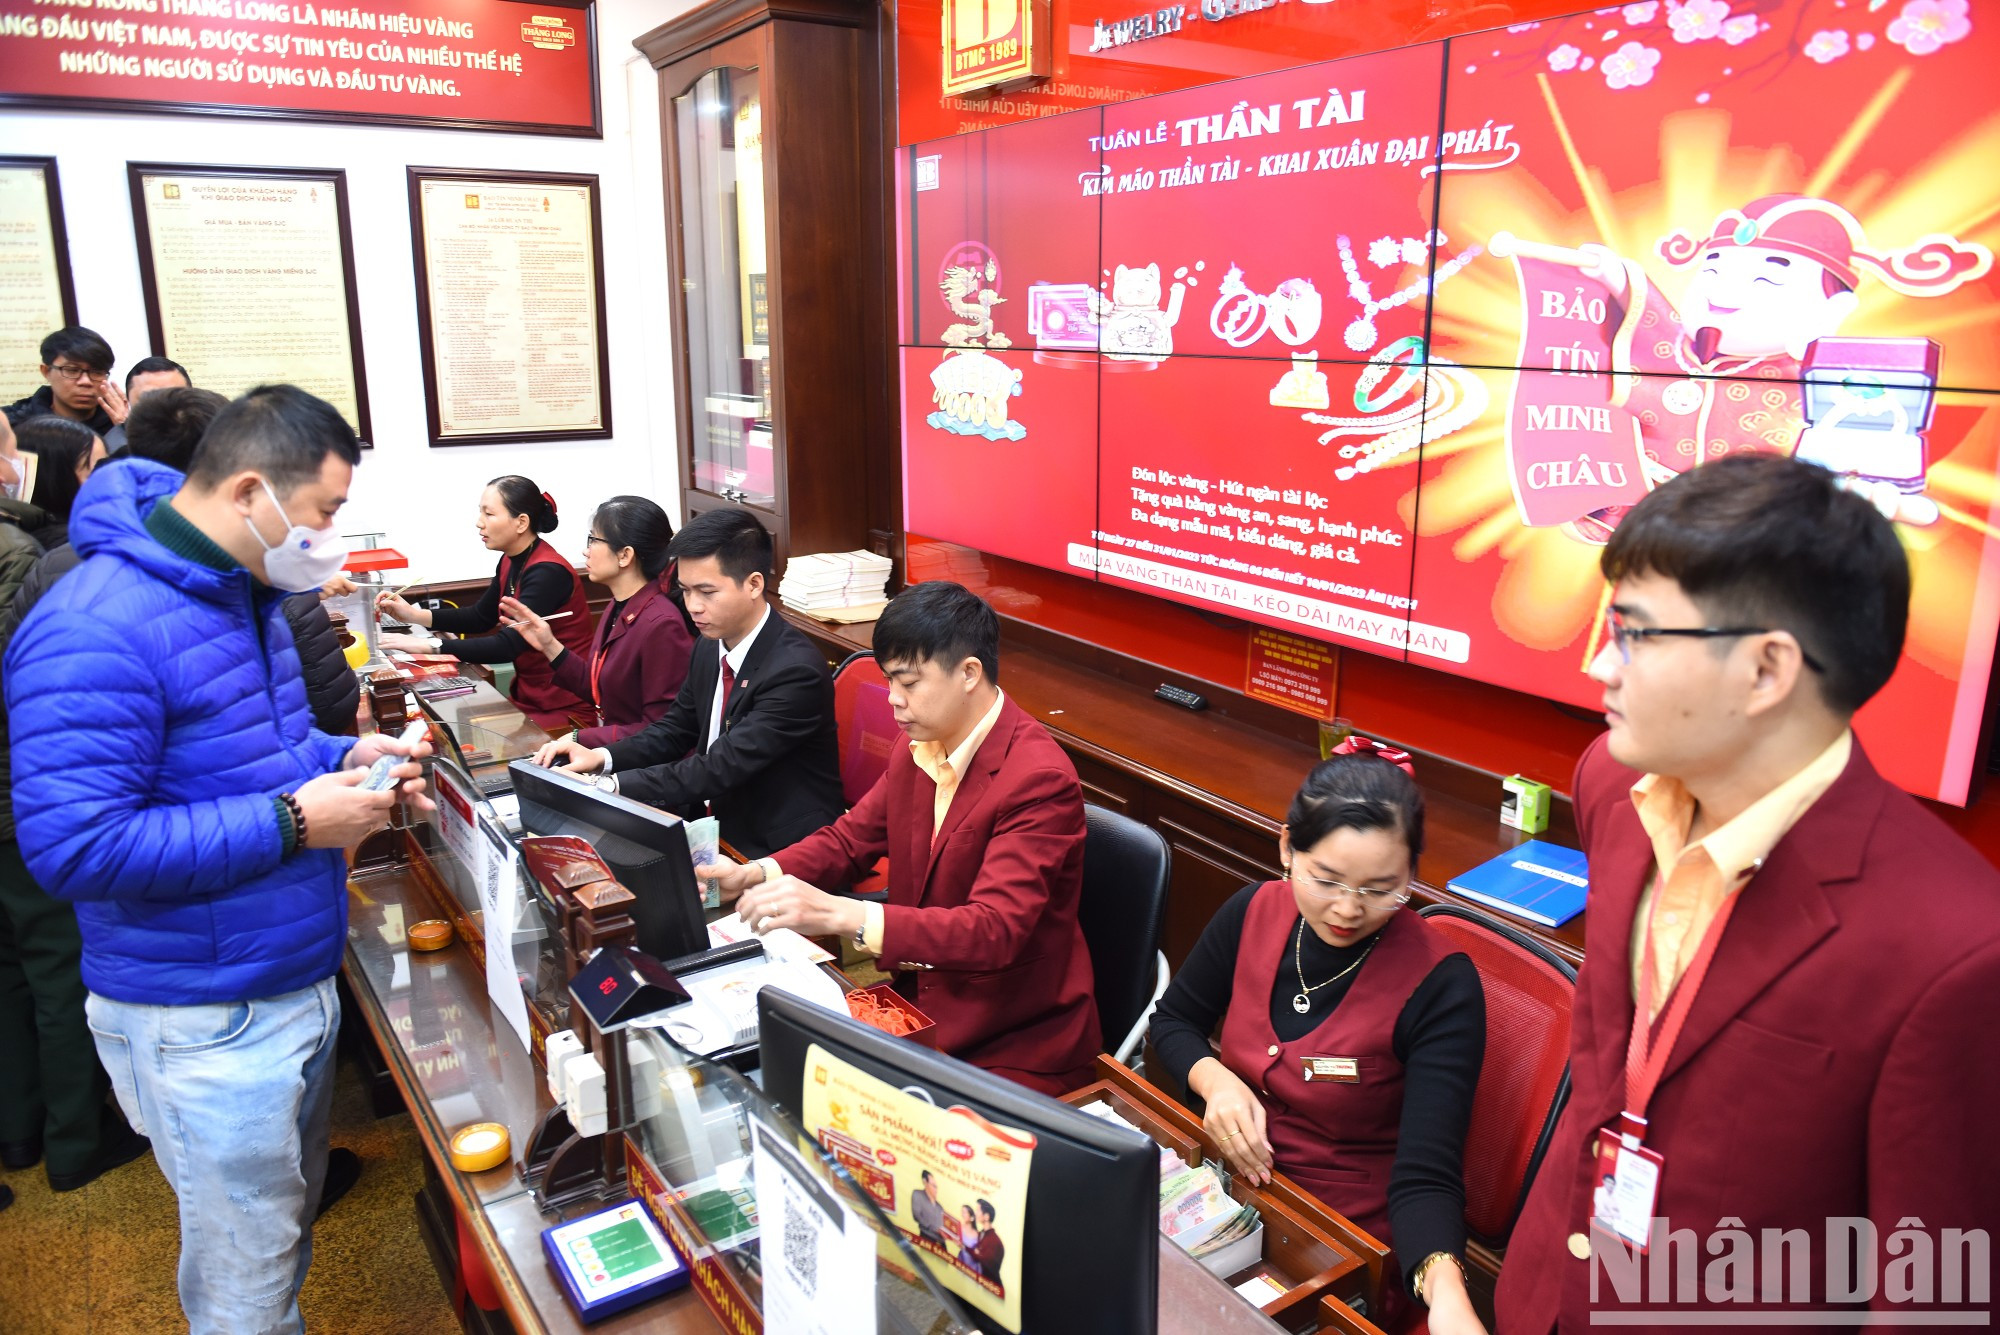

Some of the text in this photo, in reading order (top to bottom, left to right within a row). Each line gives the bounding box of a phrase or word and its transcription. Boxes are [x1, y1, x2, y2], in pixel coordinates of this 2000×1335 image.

[236, 0, 291, 23] LONG
[293, 4, 318, 26] LÀ
[321, 8, 377, 31] NHÃN
[380, 12, 422, 38] HIỆU
[424, 16, 474, 39] VÀNG
[551, 30, 573, 39] LONG
[1088, 4, 1186, 53] JEWELRY
[41, 13, 523, 77] ĐẦU VIỆT NAM, ĐƯỢC SỰ TIN YÊU CỦA NHIỀU THẾ HỆ
[956, 38, 1017, 71] BTMC 1989
[59, 49, 461, 97] NHỮNG NGƯỜI SỬ DỤNG VÀ ĐẦU TƯ VÀNG.
[1088, 87, 1365, 152] TUẦN LỄ THẦN TÀI
[1079, 168, 1114, 196] KIM
[1117, 167, 1155, 193] MÃO
[1158, 155, 1206, 188] THẦN
[1210, 155, 1241, 182] TÀI
[1257, 151, 1311, 177] KHAI
[1312, 138, 1380, 171] XUÂN
[1384, 135, 1430, 167] ĐẠI
[1432, 119, 1518, 165] PHÁT
[1540, 287, 1607, 324] BẢO
[1545, 341, 1600, 379] TÍN
[1525, 404, 1613, 433] MINH
[1132, 466, 1328, 510] Đón lộc vàng Hút ngàn tài lộc
[1526, 453, 1628, 490] CHÂU
[1130, 487, 1403, 547] Tặng quà bằng vàng an, sang, hạnh phúc
[1131, 507, 1360, 564] Đa dạng mẫu mã, kiểu dáng, giá cả.
[1078, 551, 1113, 571] MUA
[1116, 560, 1158, 581] VÀNG
[1211, 583, 1237, 601] TÀI
[1253, 594, 1290, 613] KÉO
[1296, 604, 1330, 624] DÀI
[1337, 614, 1384, 636] MAY
